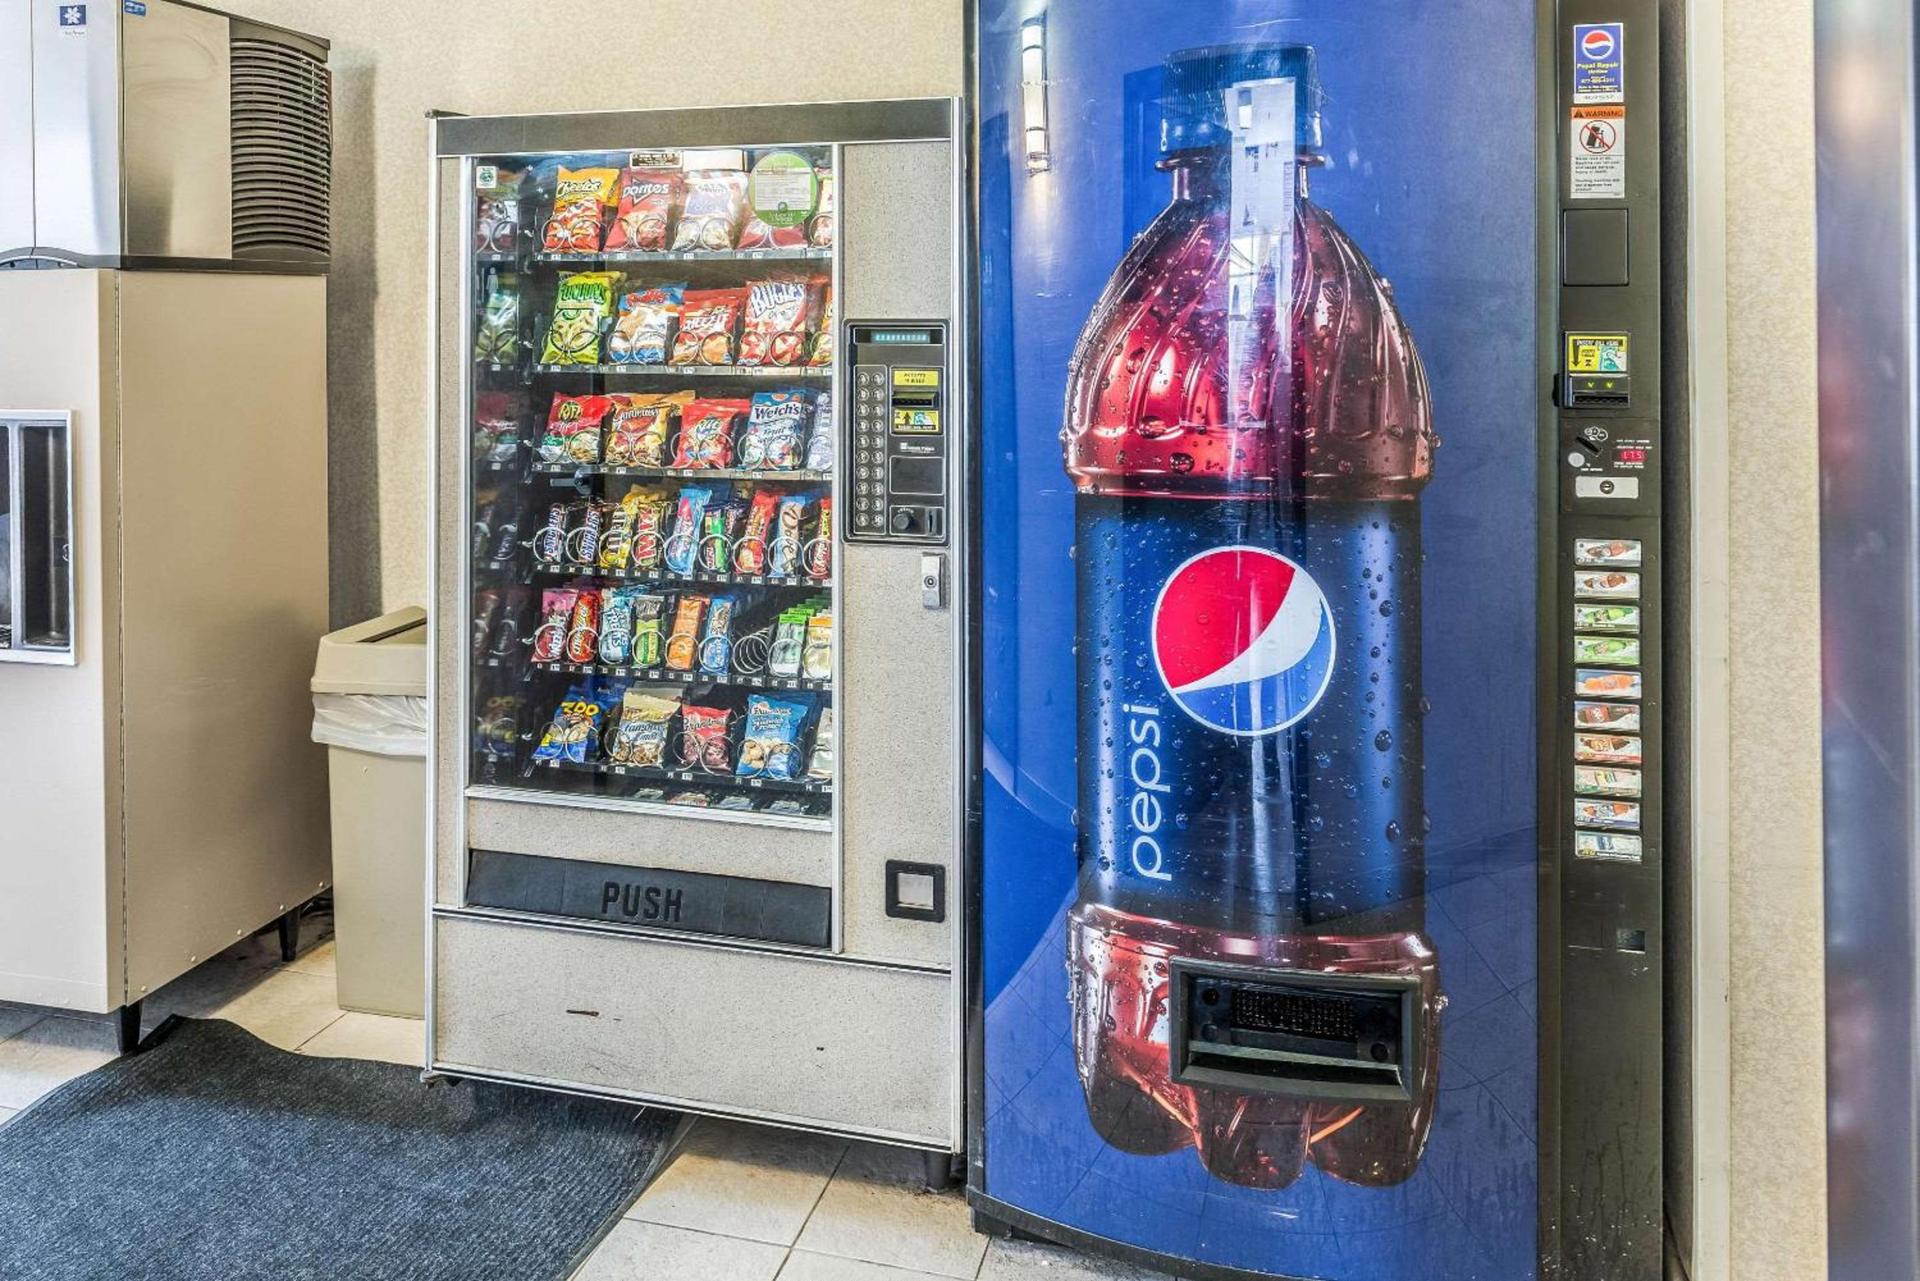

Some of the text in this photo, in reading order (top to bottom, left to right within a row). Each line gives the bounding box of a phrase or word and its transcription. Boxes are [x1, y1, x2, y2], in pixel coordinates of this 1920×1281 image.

[754, 402, 802, 420] Welch's
[1122, 703, 1173, 882] pepsi
[601, 881, 683, 921] PUSH
